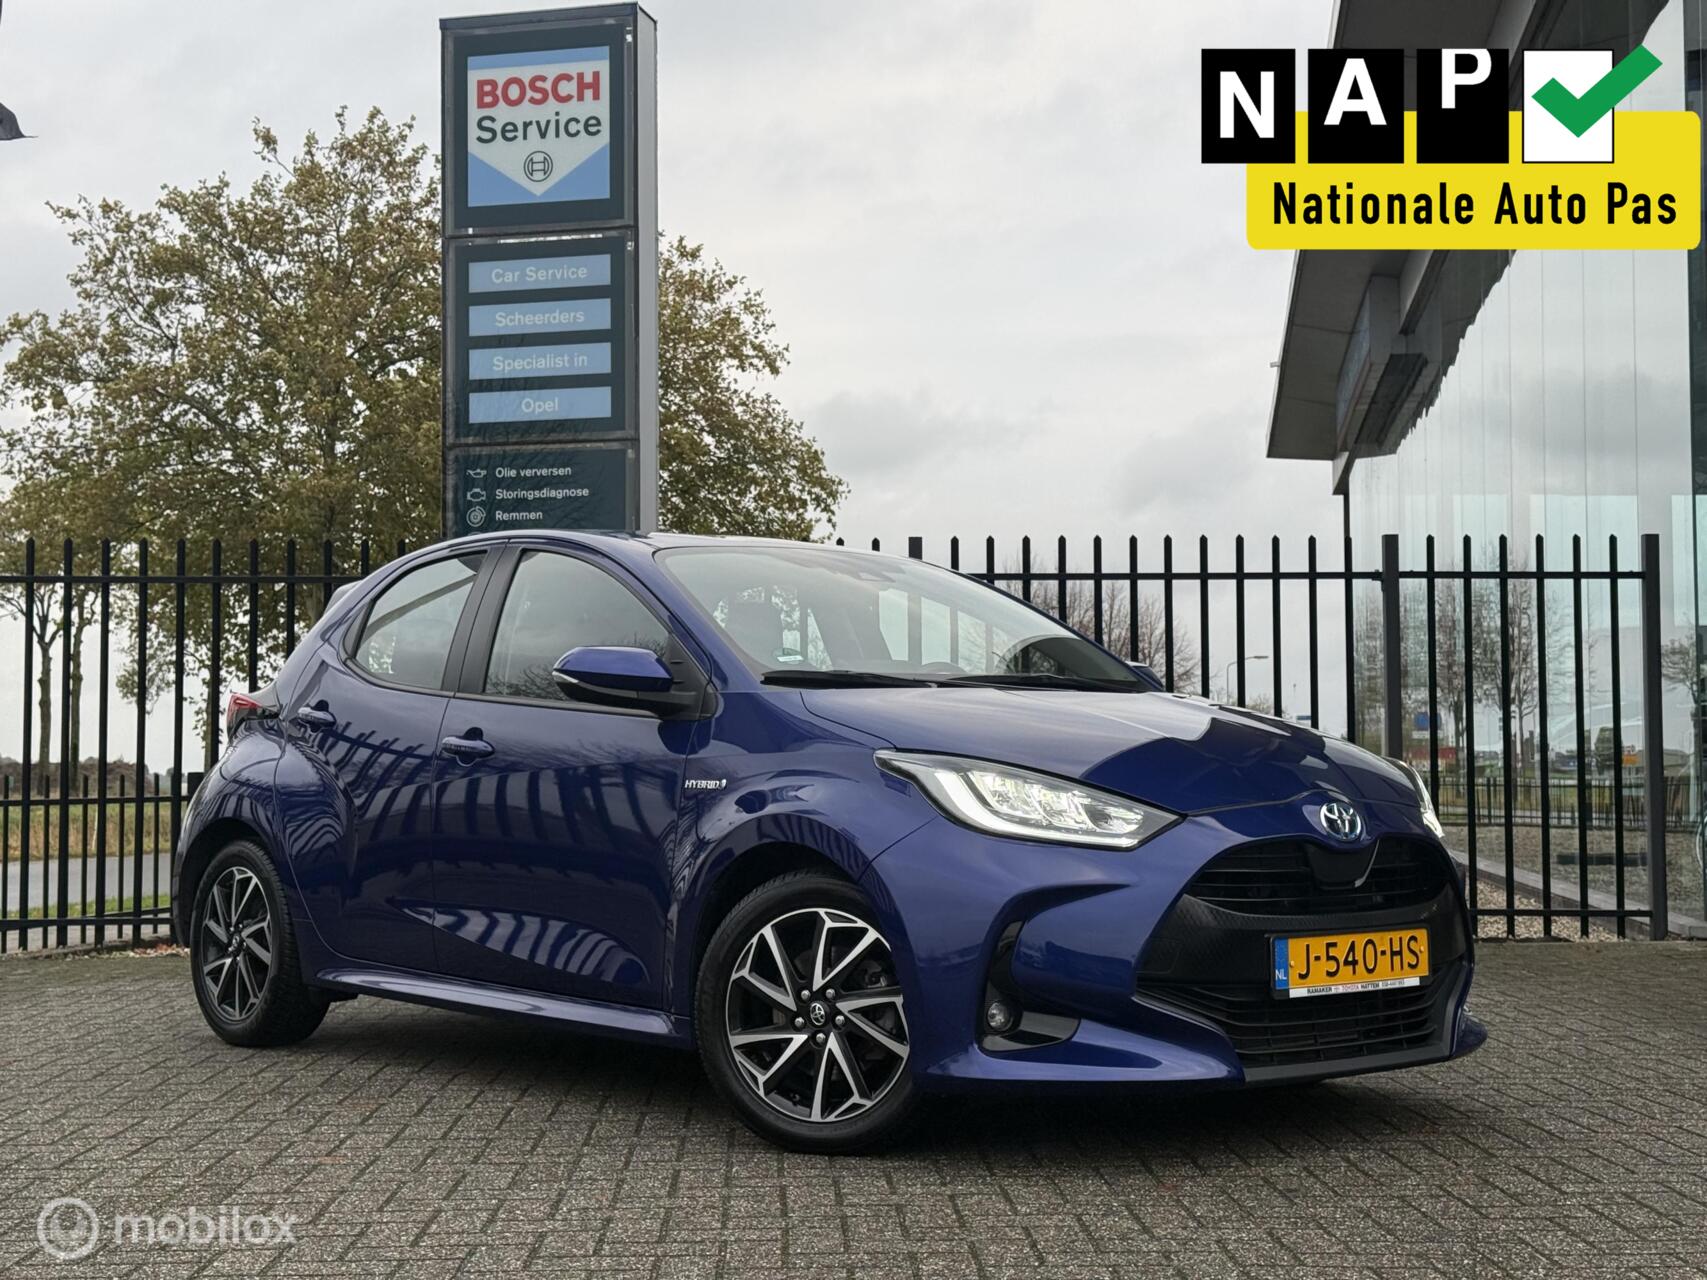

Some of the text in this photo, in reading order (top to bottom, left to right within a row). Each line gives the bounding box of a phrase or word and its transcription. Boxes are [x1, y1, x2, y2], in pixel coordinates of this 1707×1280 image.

[476, 71, 601, 109] BOSCH
[476, 111, 602, 144] Service
[491, 265, 588, 284] Car Service
[495, 309, 585, 327] Scheerders
[492, 353, 588, 373] Specialist in
[521, 397, 559, 416] Opel
[495, 466, 572, 479] Olie verversen
[495, 486, 590, 501] Storingsdiagnose
[495, 510, 543, 521] Remmen
[684, 779, 720, 789] HYBRID
[1297, 935, 1420, 980] J-540-HS
[1275, 968, 1287, 980] NL
